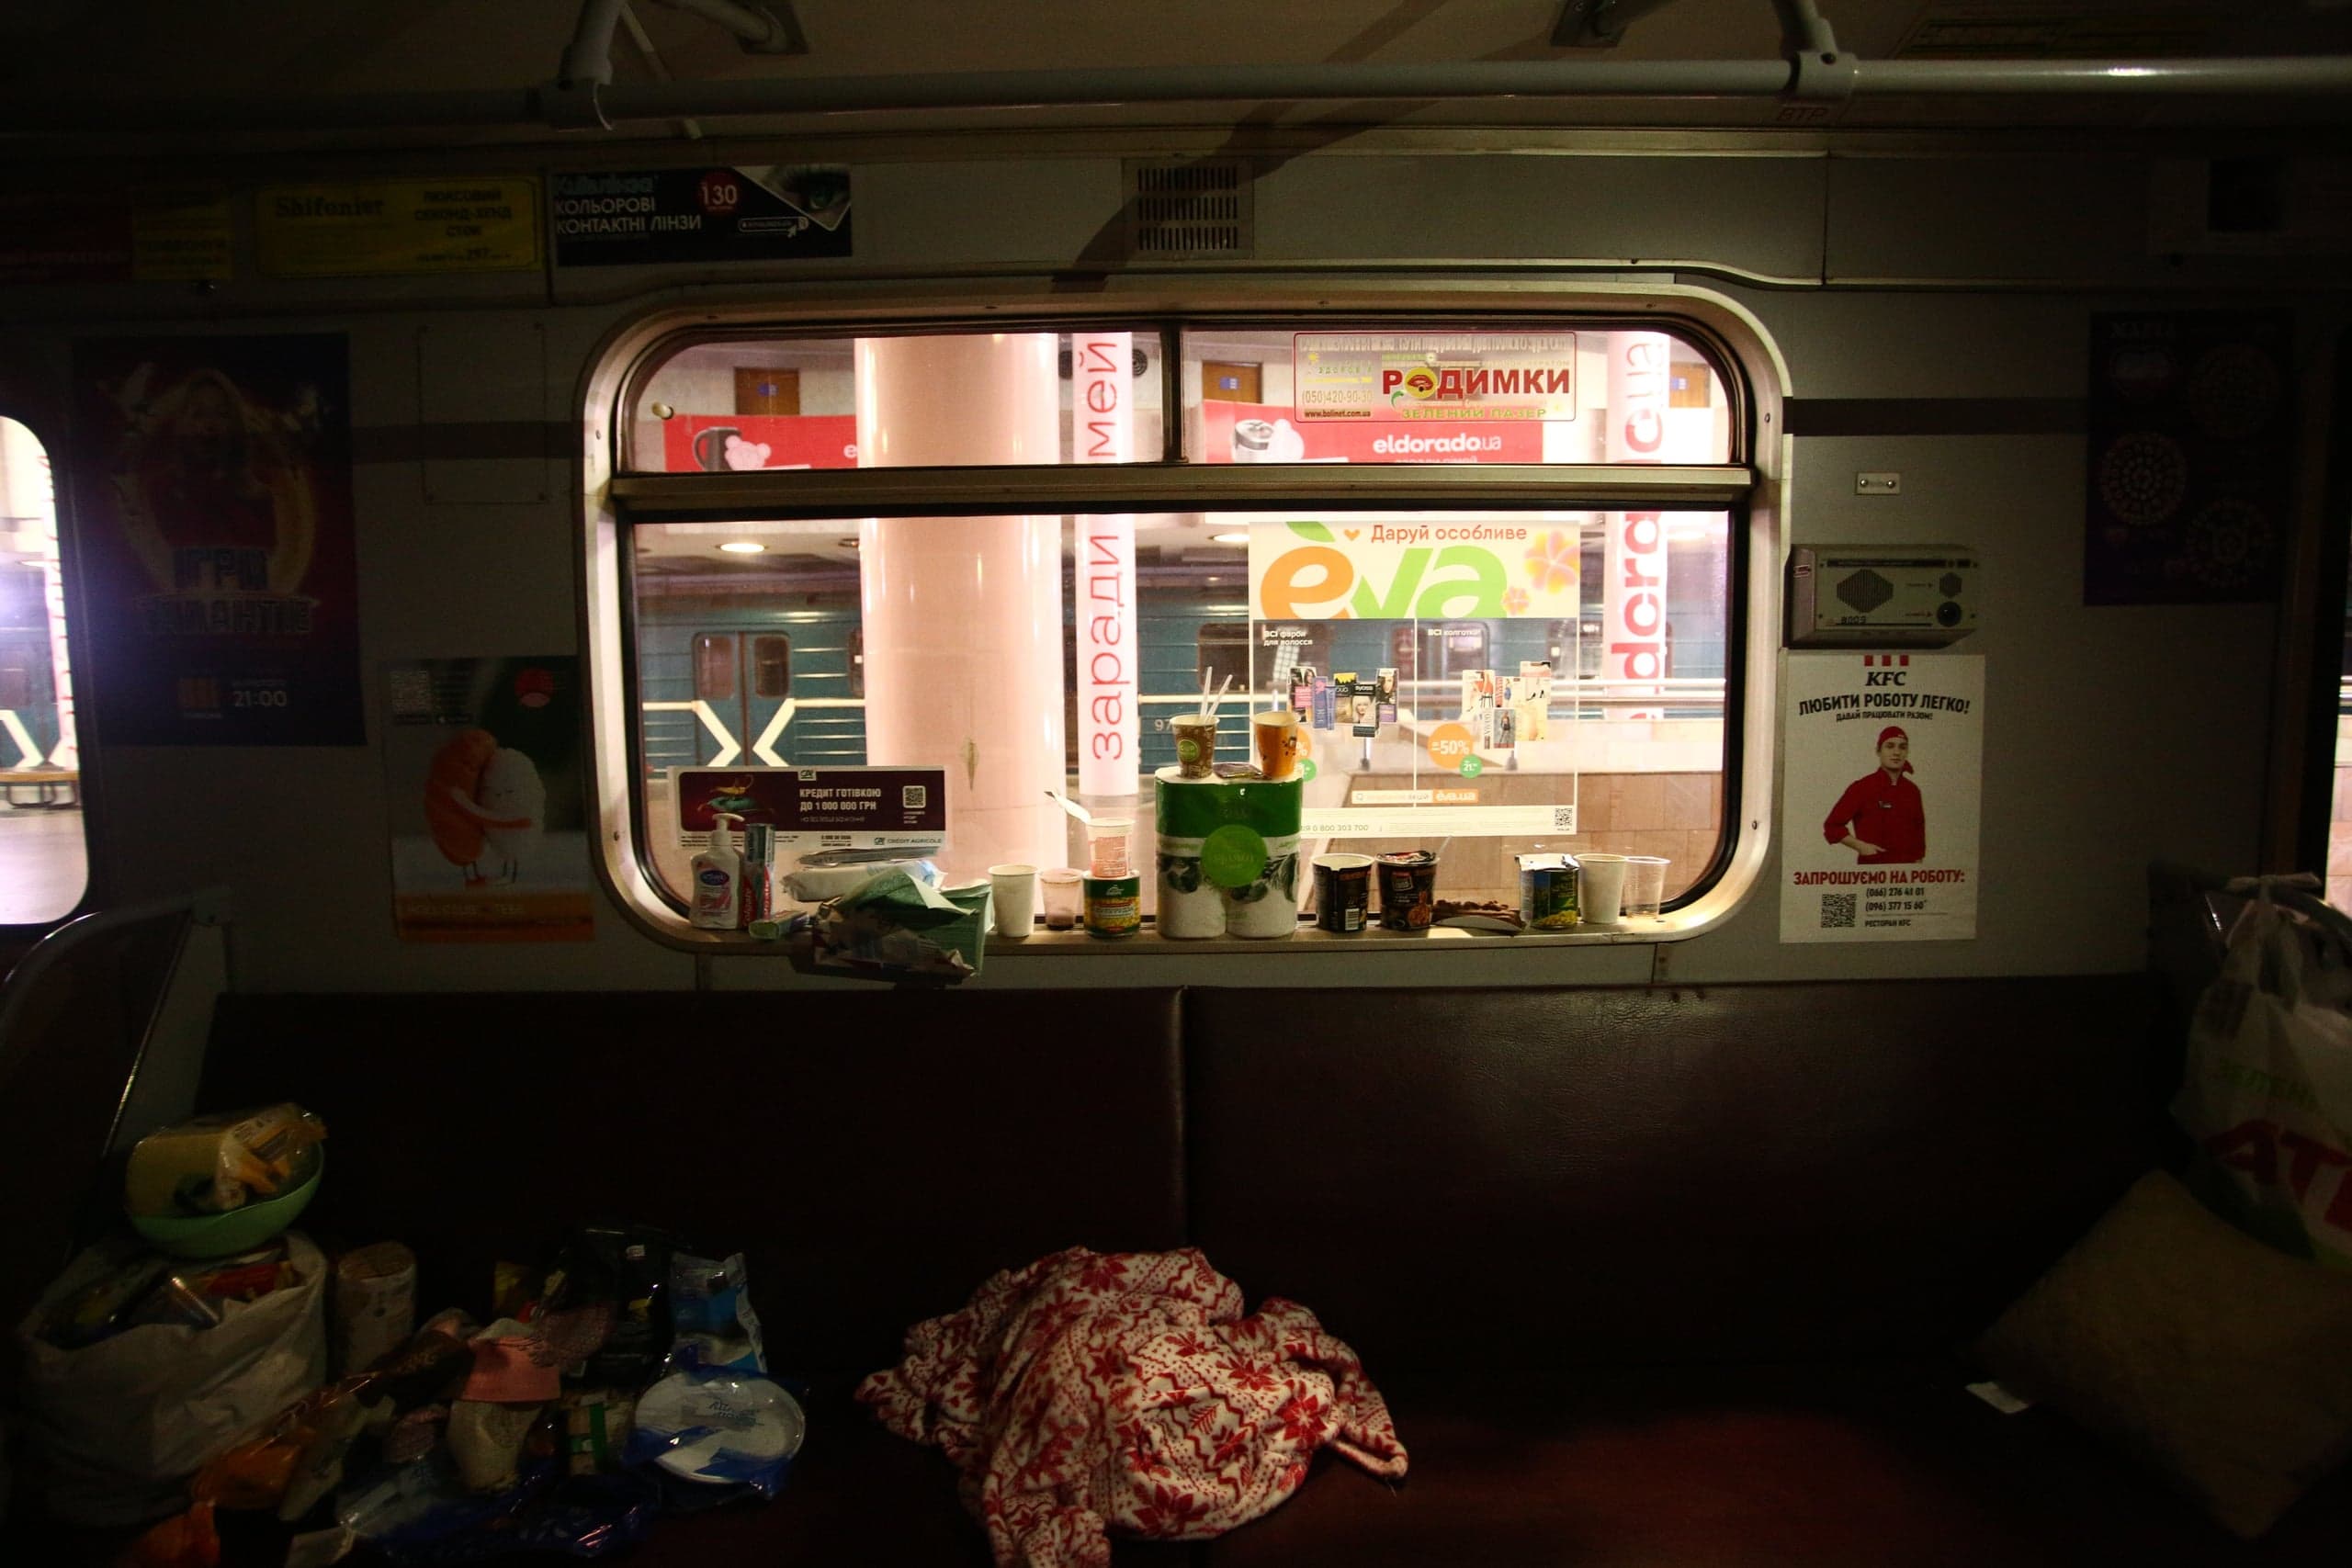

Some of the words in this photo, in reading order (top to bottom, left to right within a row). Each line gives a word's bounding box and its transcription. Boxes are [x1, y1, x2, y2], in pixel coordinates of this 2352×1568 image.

[702, 183, 739, 205] 130
[556, 194, 657, 217] КОЛЬОРОВІ
[556, 216, 647, 237] КОНТАКТНІ
[650, 213, 703, 234] ЛІНЗИ
[1373, 433, 1502, 454] eldorado.ua
[1370, 524, 1430, 544] Даруй
[1434, 524, 1528, 541] особливе
[1089, 536, 1131, 761] заради
[1864, 671, 1906, 686] KFC
[234, 690, 288, 707] 21:00
[1798, 694, 1860, 716] ЛЮБИТИ
[1864, 693, 1918, 707] РОБОТУ
[1920, 694, 1971, 715] ЛЕГКО!
[1836, 710, 1860, 722] ДАВАЙ
[1862, 711, 1905, 720] ПРАЦЮВАТИ
[799, 788, 833, 799] КРЕДИТ
[835, 788, 881, 798] ГОТІВКОЮ
[799, 802, 813, 812] ДО
[815, 802, 820, 810] 1
[821, 802, 838, 810] 000
[840, 802, 857, 810] 000
[859, 802, 877, 810] ГРН
[1792, 870, 1886, 886] ЗАПРОШУЄМО
[1890, 871, 1908, 885] НА
[1911, 869, 1965, 885] РОБОТУ:
[1865, 901, 1886, 912] (096)
[1888, 901, 1902, 910] 377
[1903, 901, 1912, 910] 15
